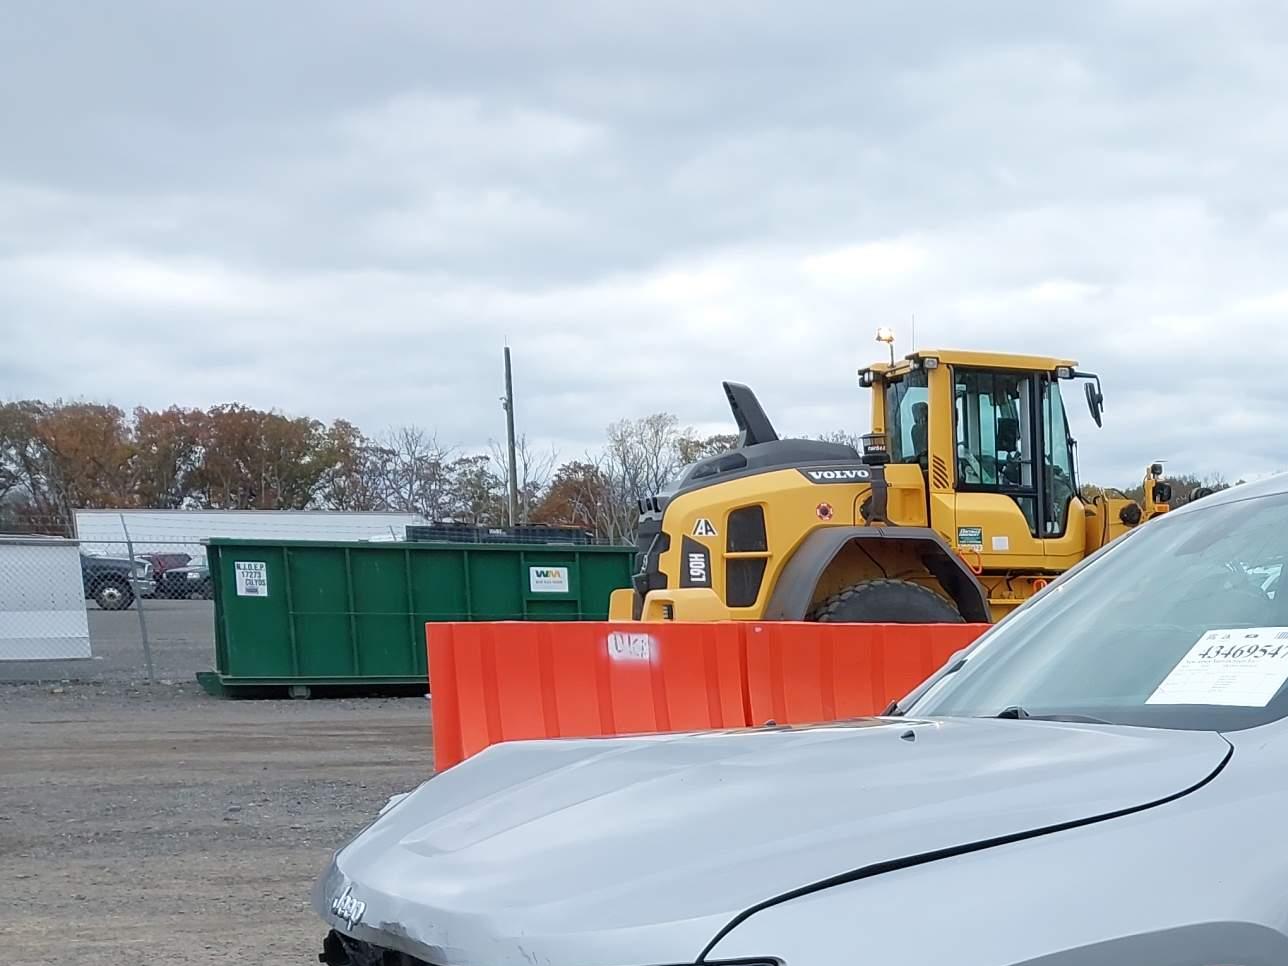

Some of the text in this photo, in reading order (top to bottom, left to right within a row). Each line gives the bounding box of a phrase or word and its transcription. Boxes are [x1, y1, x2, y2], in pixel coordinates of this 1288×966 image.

[807, 469, 870, 480] VOLVO
[535, 570, 561, 578] WM
[688, 553, 706, 582] L90H
[332, 886, 366, 931] Jeep
